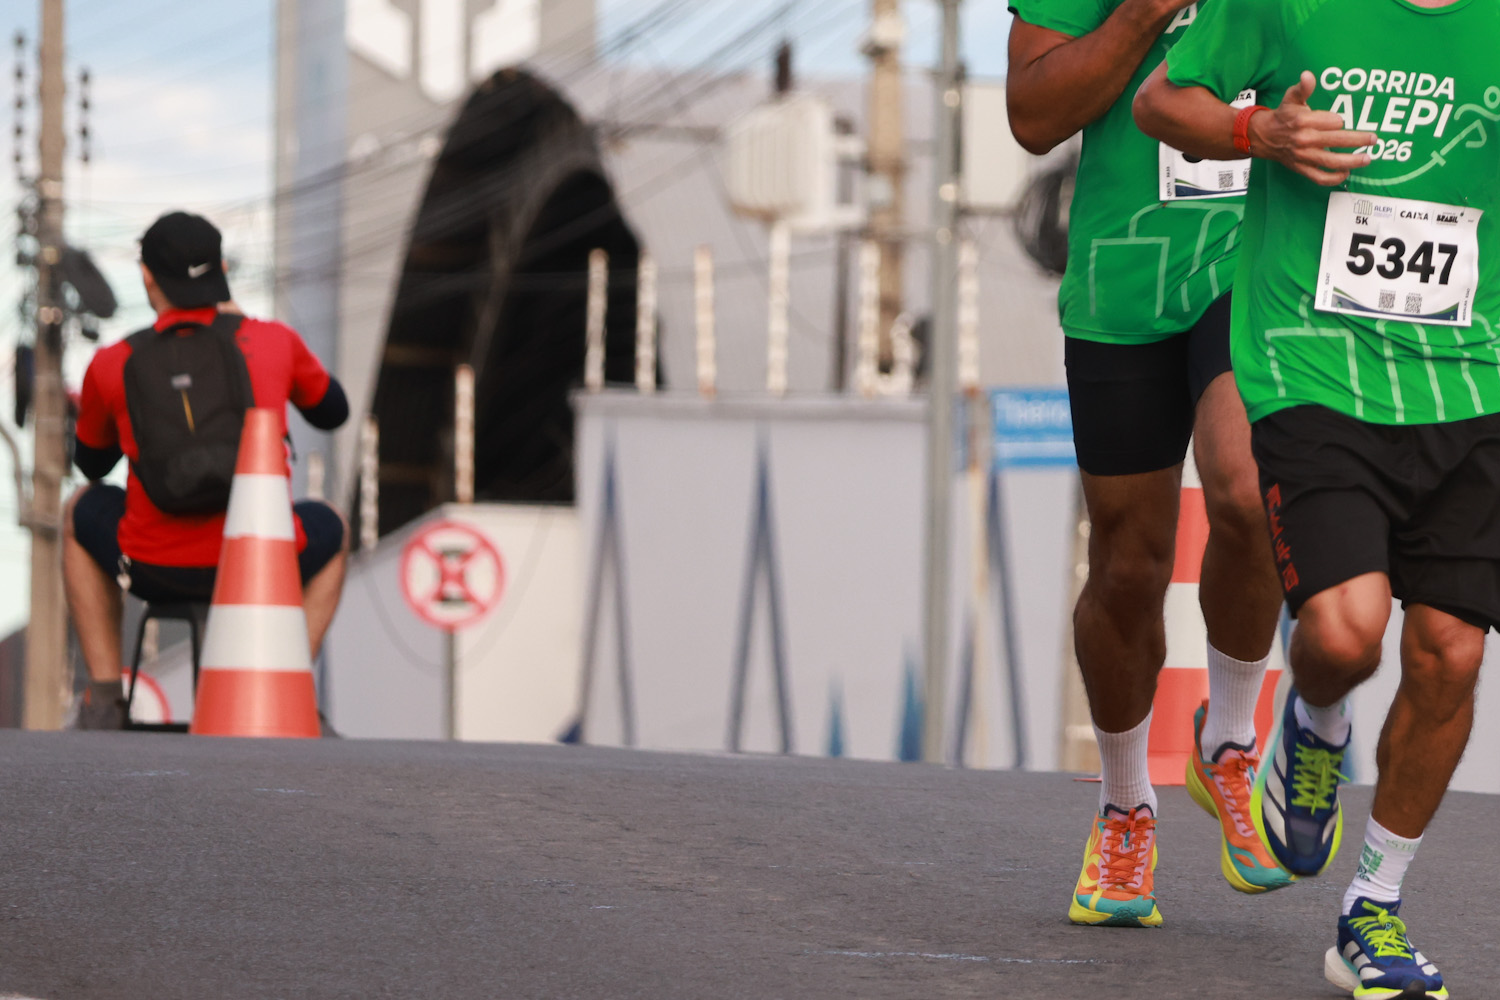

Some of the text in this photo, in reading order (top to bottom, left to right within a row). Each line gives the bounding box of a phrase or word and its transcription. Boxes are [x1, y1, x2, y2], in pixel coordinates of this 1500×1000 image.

[1320, 66, 1455, 101] CORRIDA
[1329, 93, 1453, 138] ALEPI
[1355, 215, 1369, 226] 5K
[1374, 204, 1393, 214] ALEPI
[1400, 210, 1429, 221] CAIXA
[1345, 232, 1458, 286] 5347
